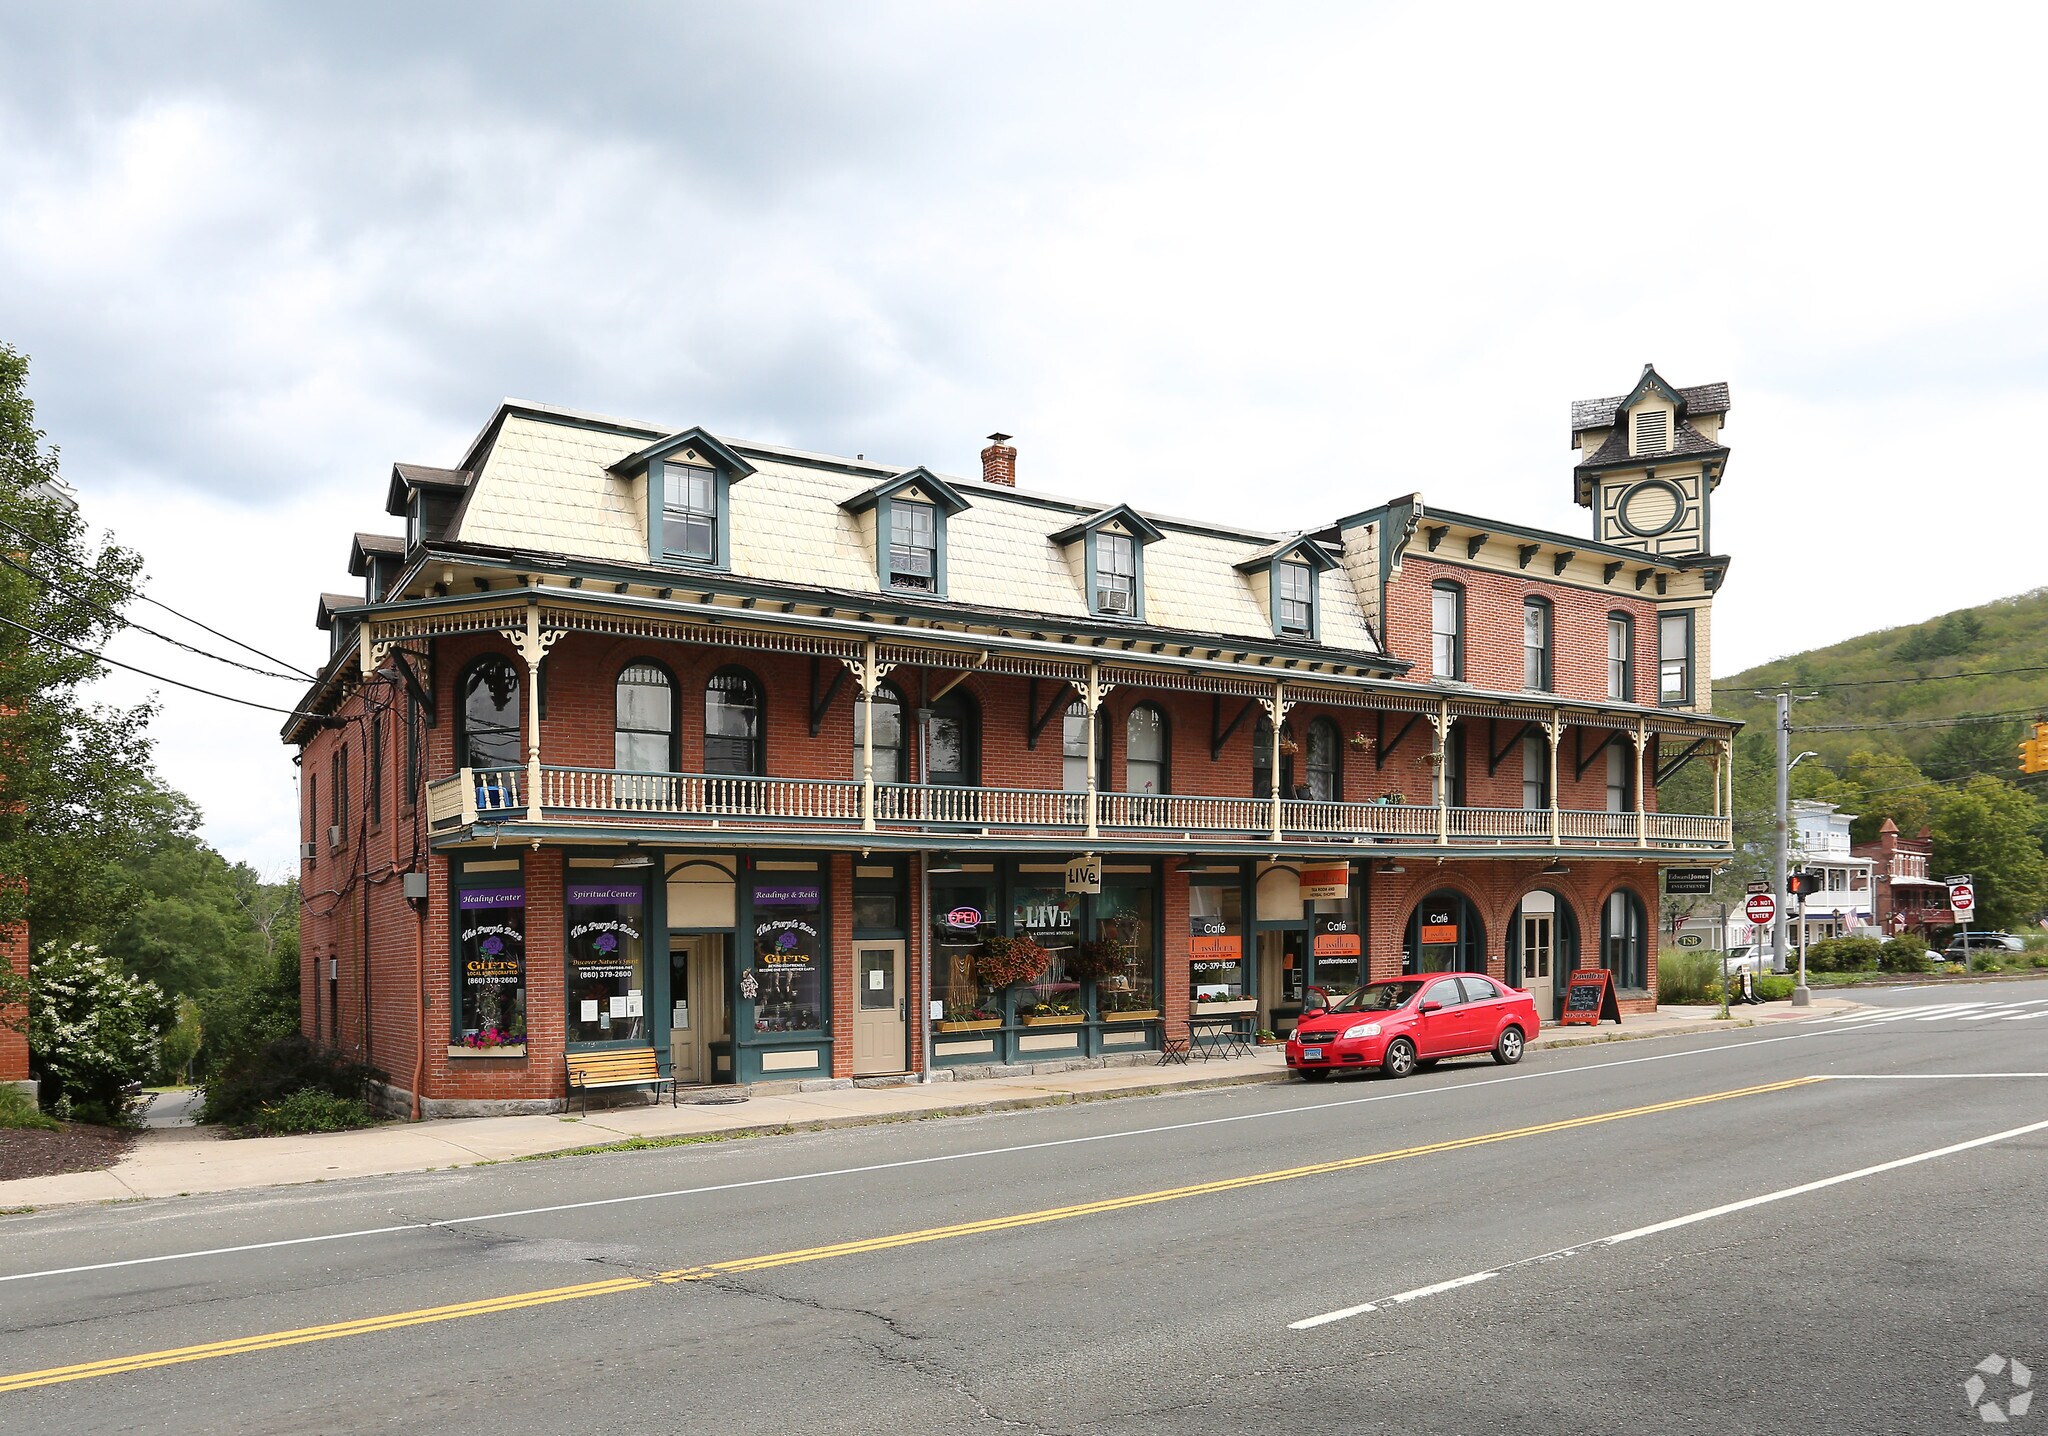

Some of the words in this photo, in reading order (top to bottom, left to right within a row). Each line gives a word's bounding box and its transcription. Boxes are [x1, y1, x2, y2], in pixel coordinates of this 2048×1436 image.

[463, 895, 494, 904] Healing
[495, 894, 521, 902] Center
[573, 890, 610, 900] Spiritual
[611, 890, 637, 898] Center
[756, 891, 789, 900] Readings
[949, 911, 978, 923] OPEN
[1026, 905, 1071, 928] LIVE
[1430, 912, 1449, 924] Café
[571, 924, 588, 939] The
[588, 920, 619, 932] Purple
[619, 924, 639, 938] Rose
[756, 923, 771, 936] The
[771, 919, 799, 930] Purple
[799, 922, 817, 936] Rose
[1204, 921, 1226, 934] Café
[1327, 920, 1347, 931] Café
[462, 929, 477, 941] The
[477, 924, 503, 935] Purple
[504, 927, 522, 941] Rose
[1682, 936, 1698, 945] TSB
[1193, 961, 1236, 971] 860-379-8327
[580, 971, 599, 980] (860)
[600, 970, 632, 978] 379-2600
[467, 977, 485, 986] (860)
[486, 976, 518, 984] 379-2600
